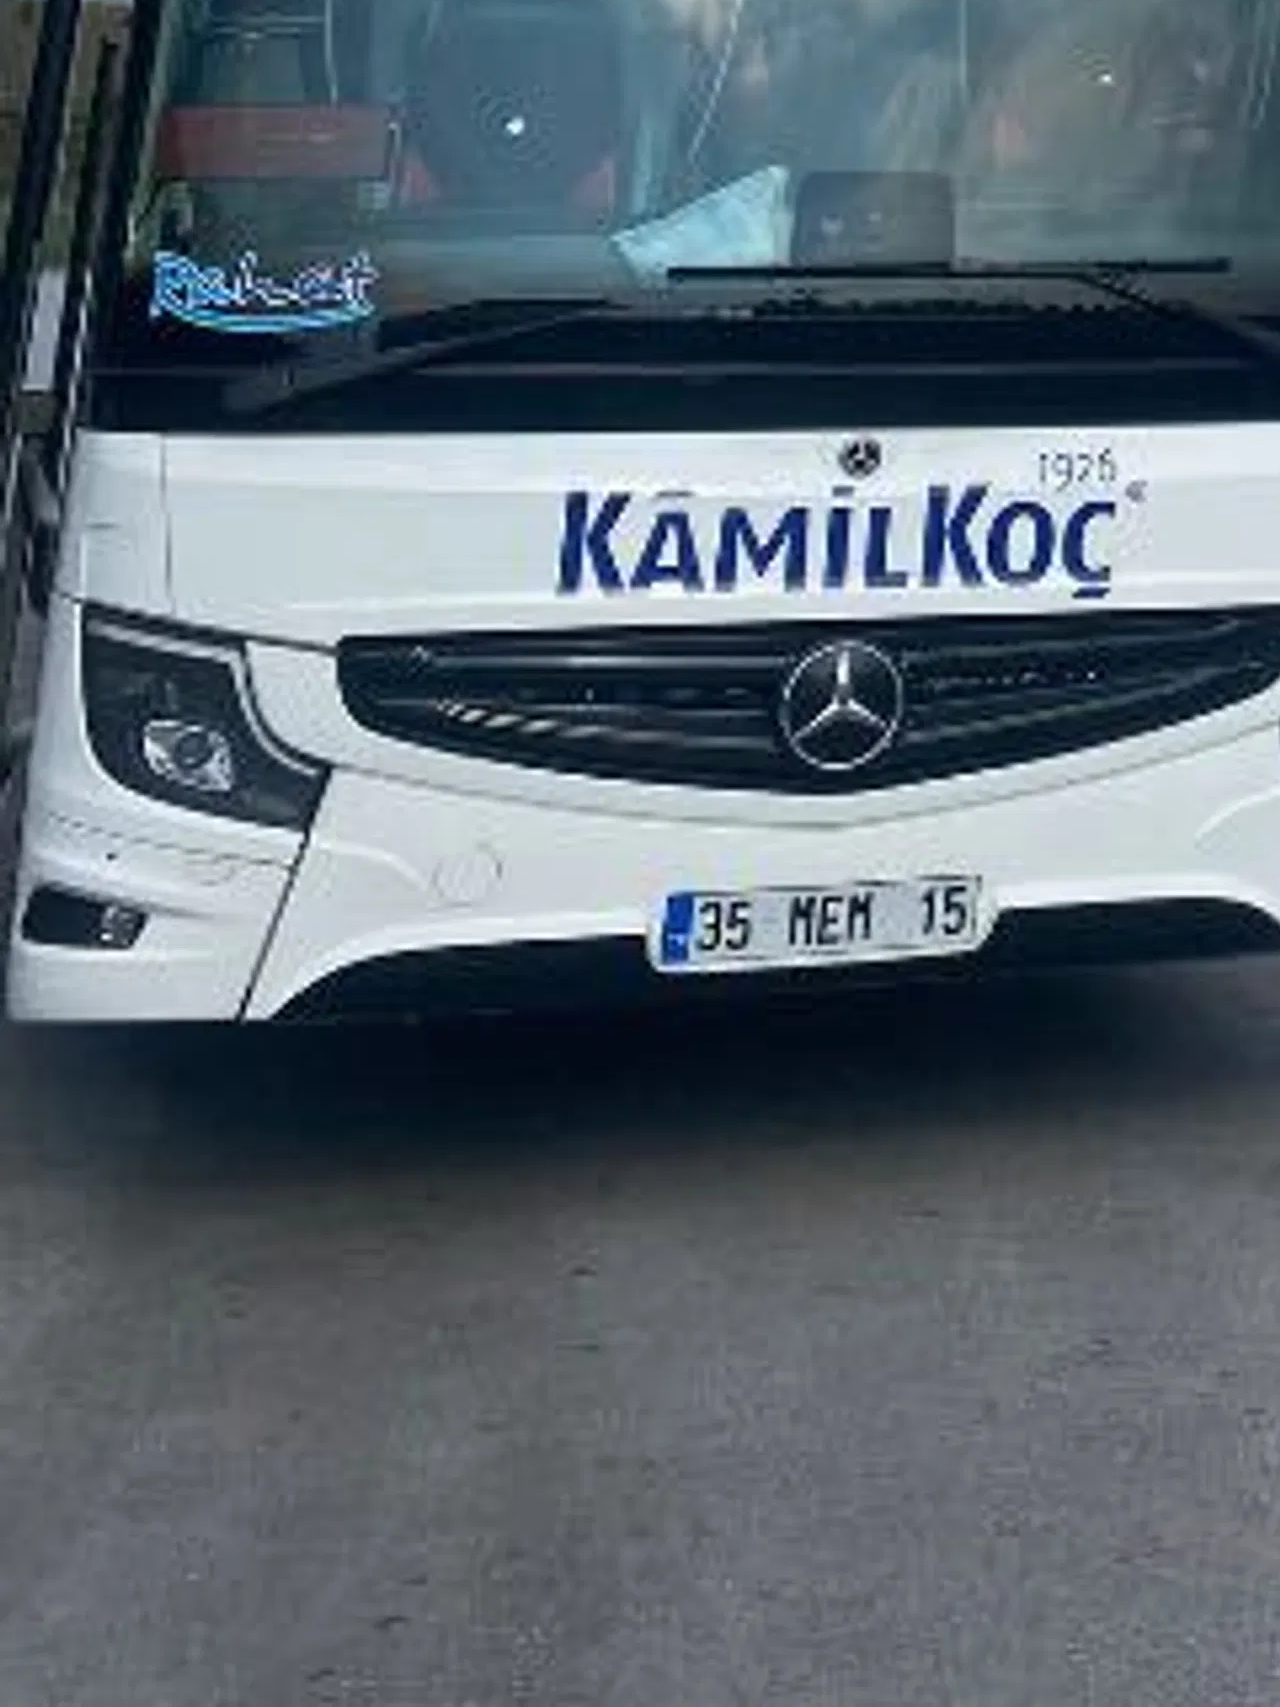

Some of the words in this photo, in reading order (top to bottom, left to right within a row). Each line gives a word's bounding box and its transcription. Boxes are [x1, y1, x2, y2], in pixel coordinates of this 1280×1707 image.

[1039, 447, 1118, 493] 1926
[697, 899, 751, 953] 35
[786, 889, 875, 947] MEM
[918, 883, 968, 936] 15
